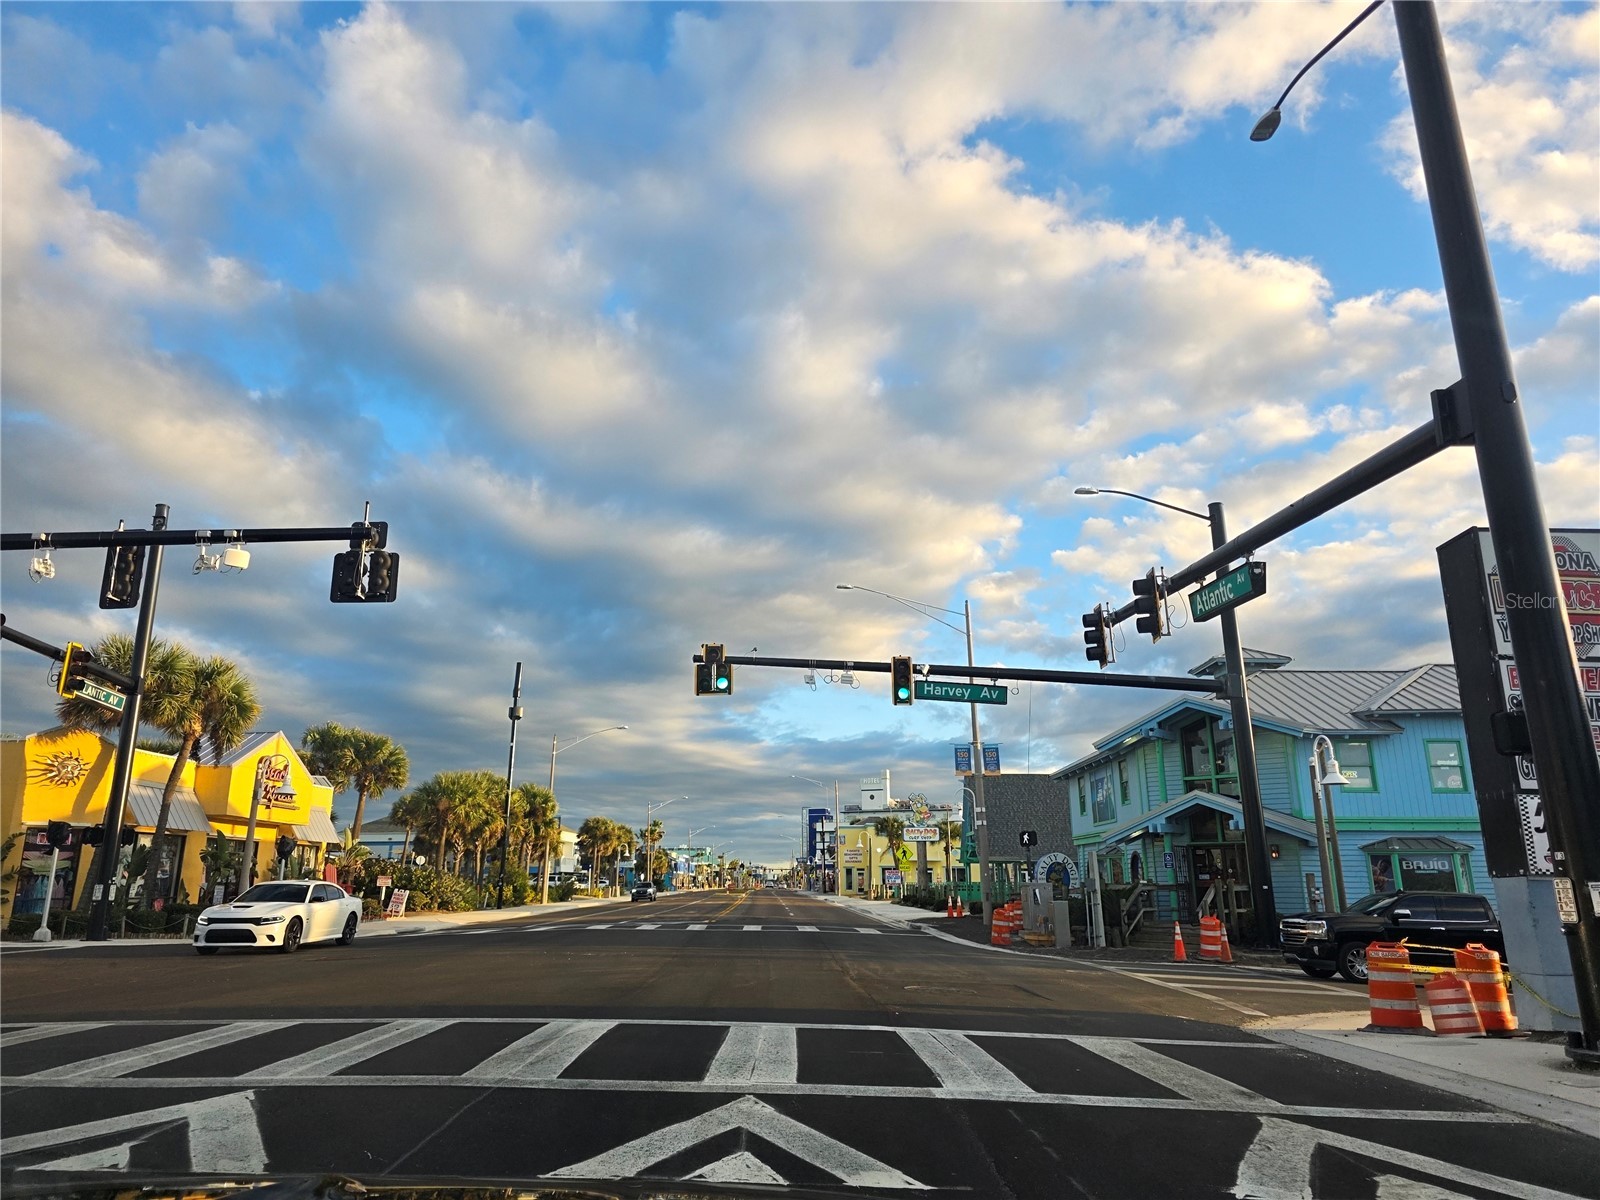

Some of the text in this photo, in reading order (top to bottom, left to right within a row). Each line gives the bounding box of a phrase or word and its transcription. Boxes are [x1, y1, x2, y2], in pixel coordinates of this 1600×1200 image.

[1196, 573, 1245, 614] Atlantic Av
[83, 684, 118, 705] LANTIC AV
[924, 683, 998, 699] Harvey Av
[1040, 853, 1076, 876] SALTY DOG
